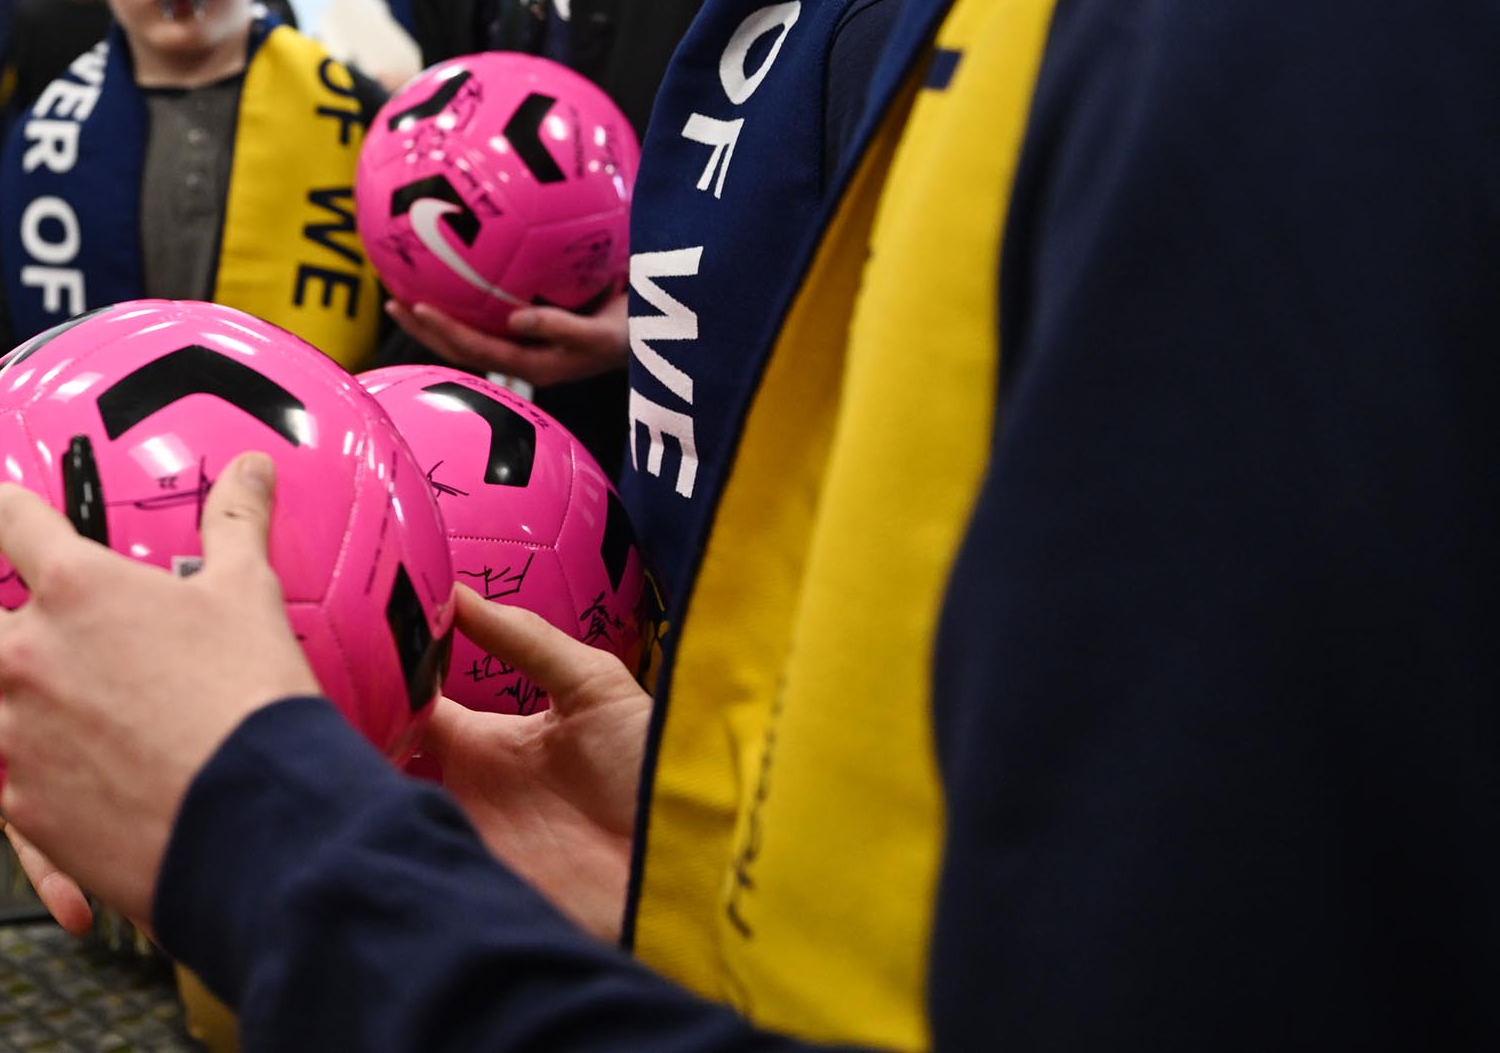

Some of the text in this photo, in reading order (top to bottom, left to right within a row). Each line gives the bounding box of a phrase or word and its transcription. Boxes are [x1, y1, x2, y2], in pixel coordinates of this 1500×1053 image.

[20, 196, 88, 317] OF
[291, 56, 366, 319] OF WE
[627, 0, 801, 500] OF WE
